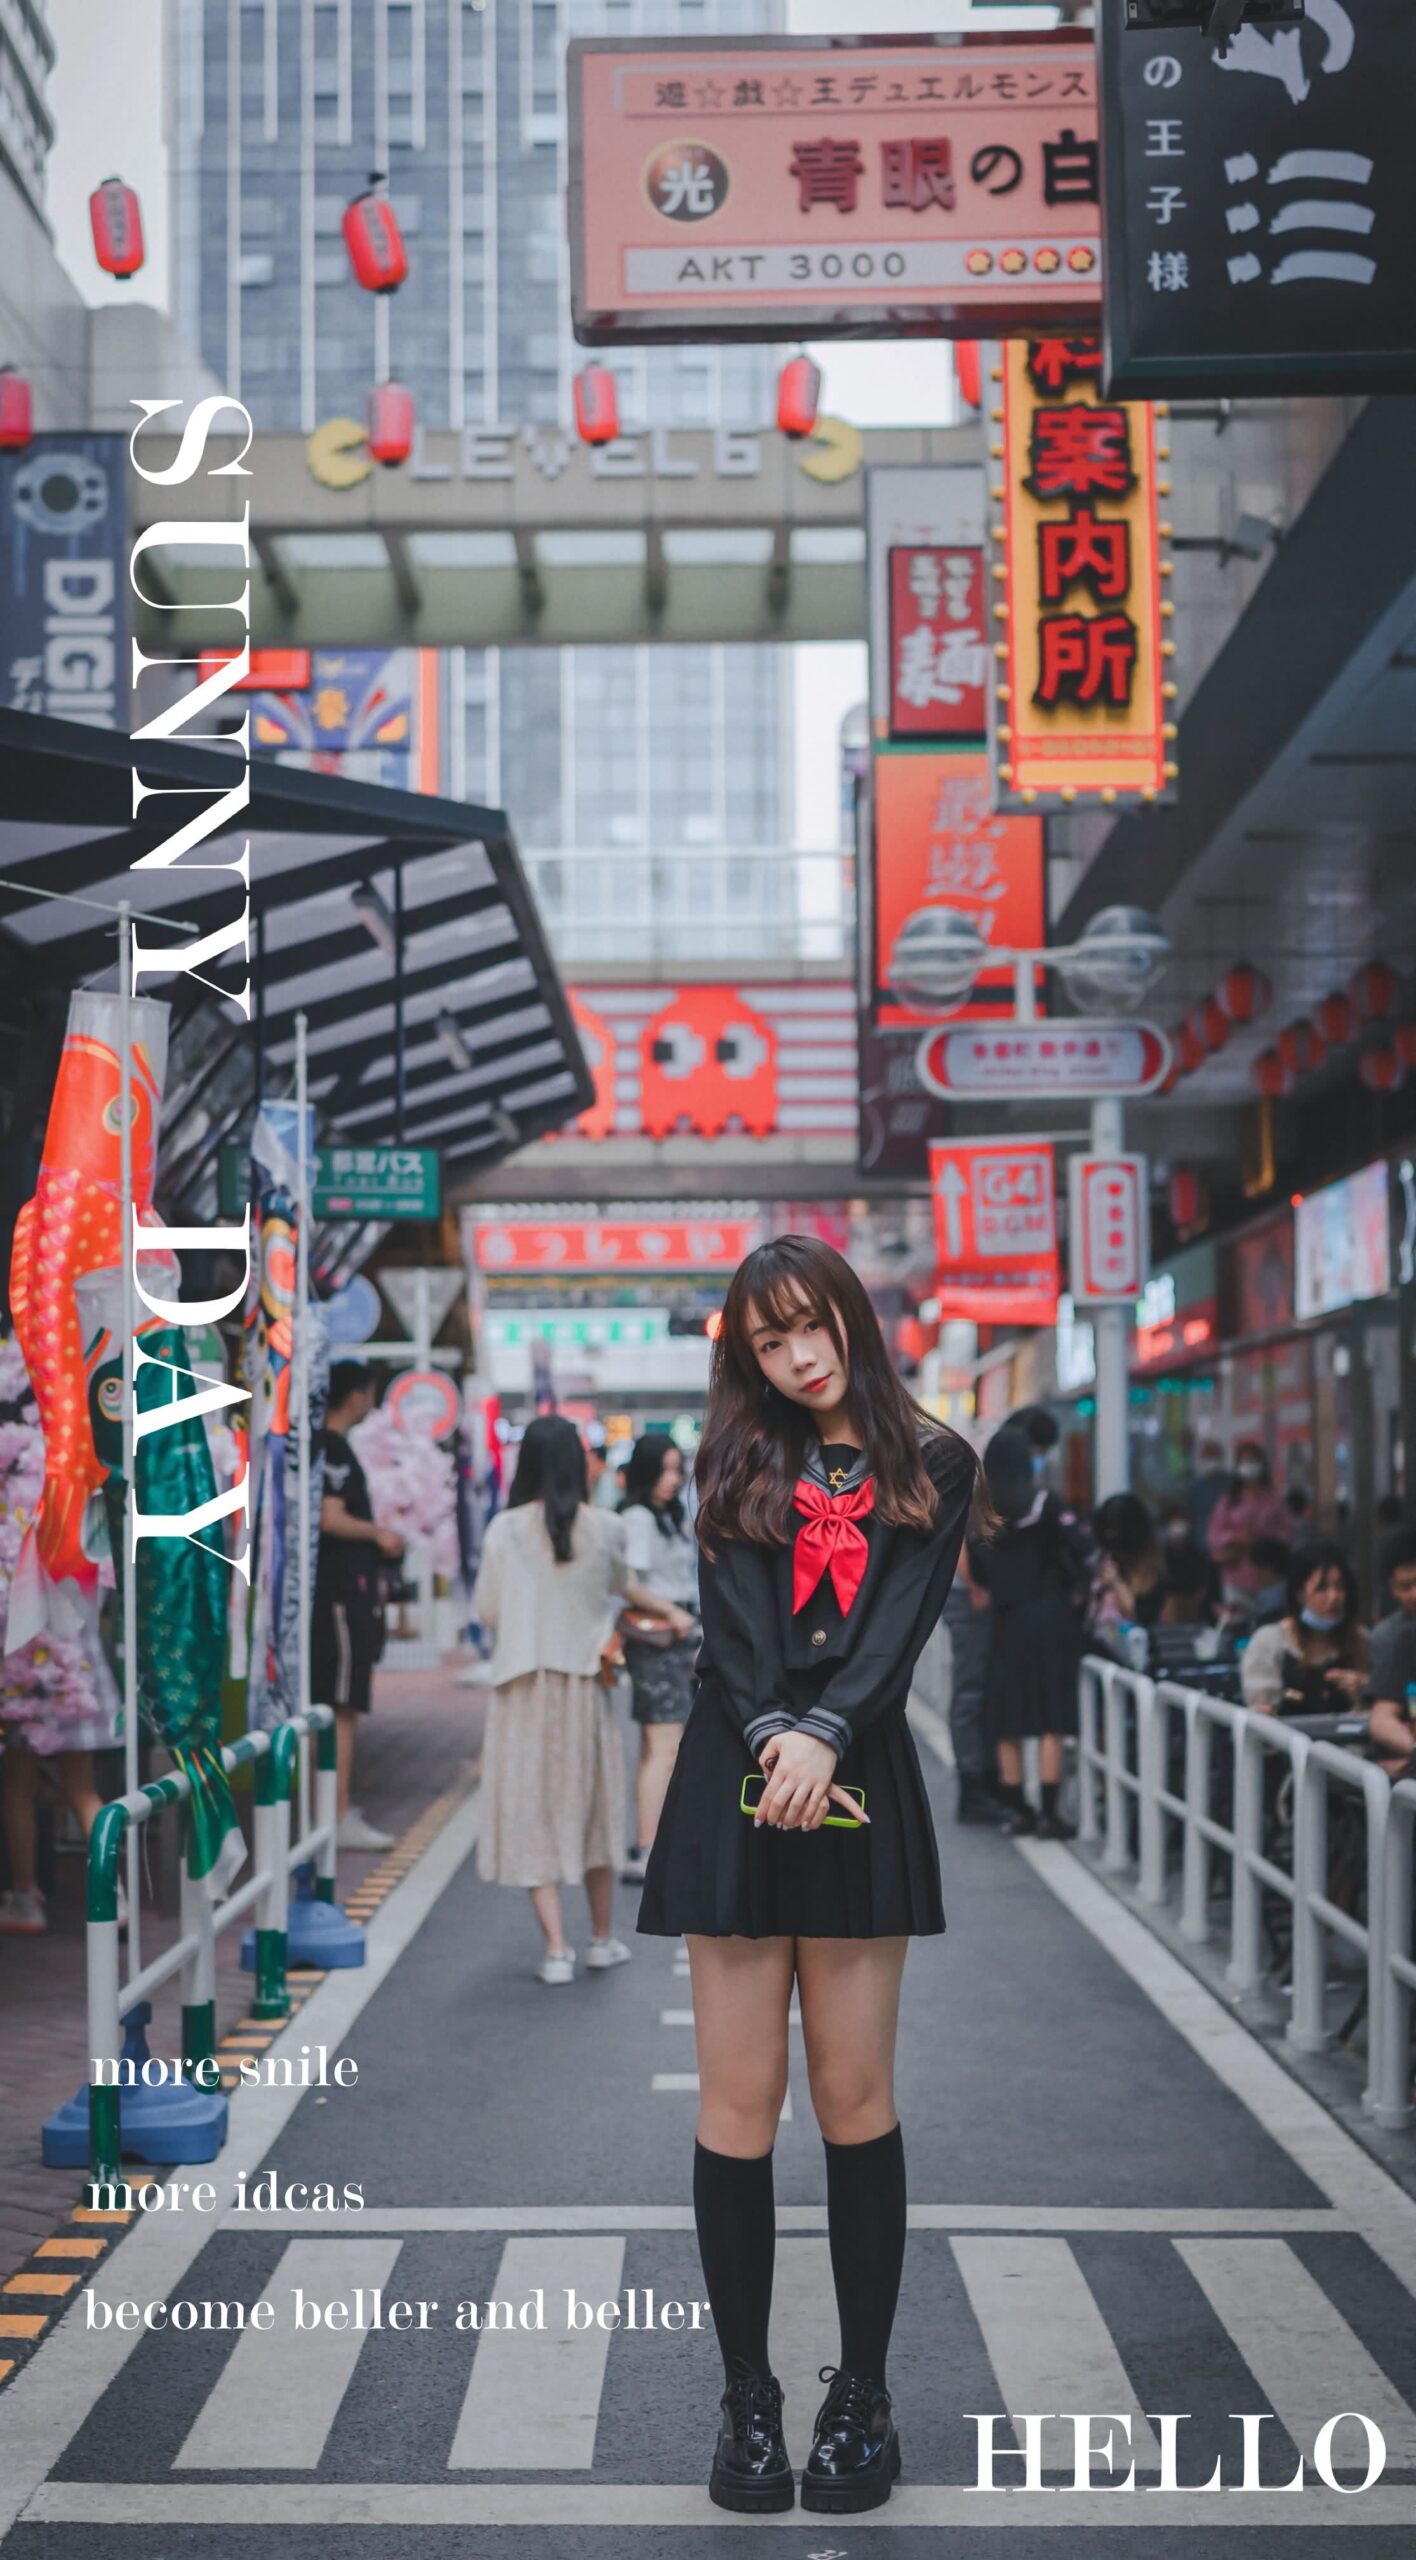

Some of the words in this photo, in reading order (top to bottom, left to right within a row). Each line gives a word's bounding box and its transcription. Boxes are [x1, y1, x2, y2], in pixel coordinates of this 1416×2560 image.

[660, 160, 715, 214] 光
[1143, 55, 1190, 292] の王子様
[677, 255, 764, 282] AKT
[789, 252, 906, 280] 3000
[43, 558, 116, 730] DIGI
